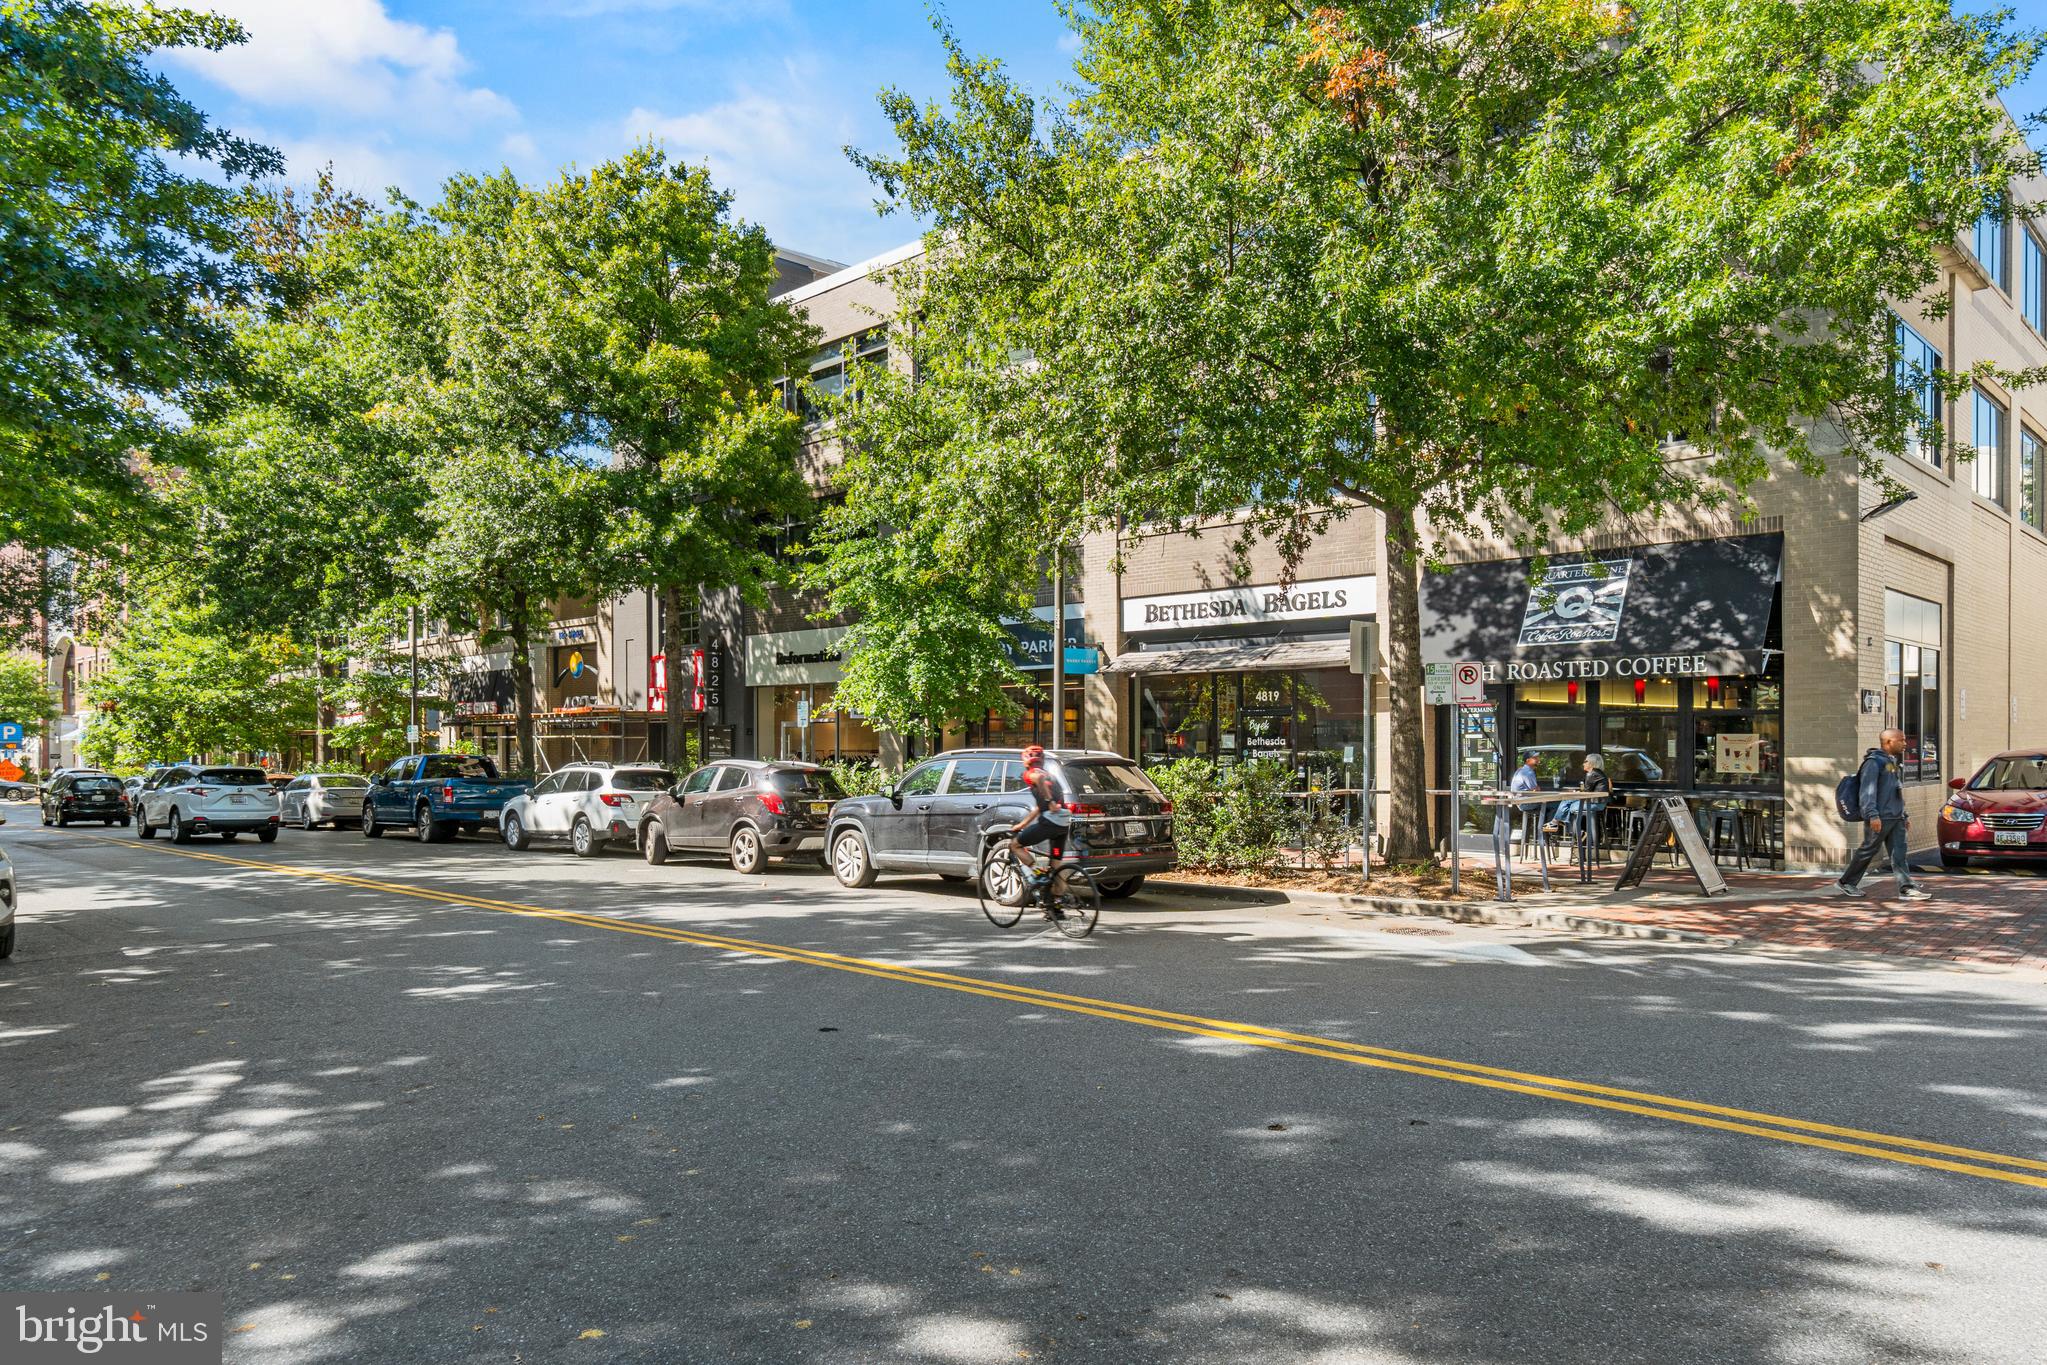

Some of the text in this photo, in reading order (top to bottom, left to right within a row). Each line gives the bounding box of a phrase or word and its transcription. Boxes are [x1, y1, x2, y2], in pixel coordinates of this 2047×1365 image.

[1145, 589, 1347, 623] BETHESDA BAGELS
[1527, 627, 1607, 642] Coffee Roasters
[1426, 665, 1435, 673] 15
[1507, 659, 1609, 680] ROASTED
[1616, 655, 1708, 676] COFFEE
[1255, 690, 1280, 701] 4819
[3, 726, 16, 740] P
[1247, 736, 1286, 746] Bethesda
[1252, 748, 1280, 759] Bagels
